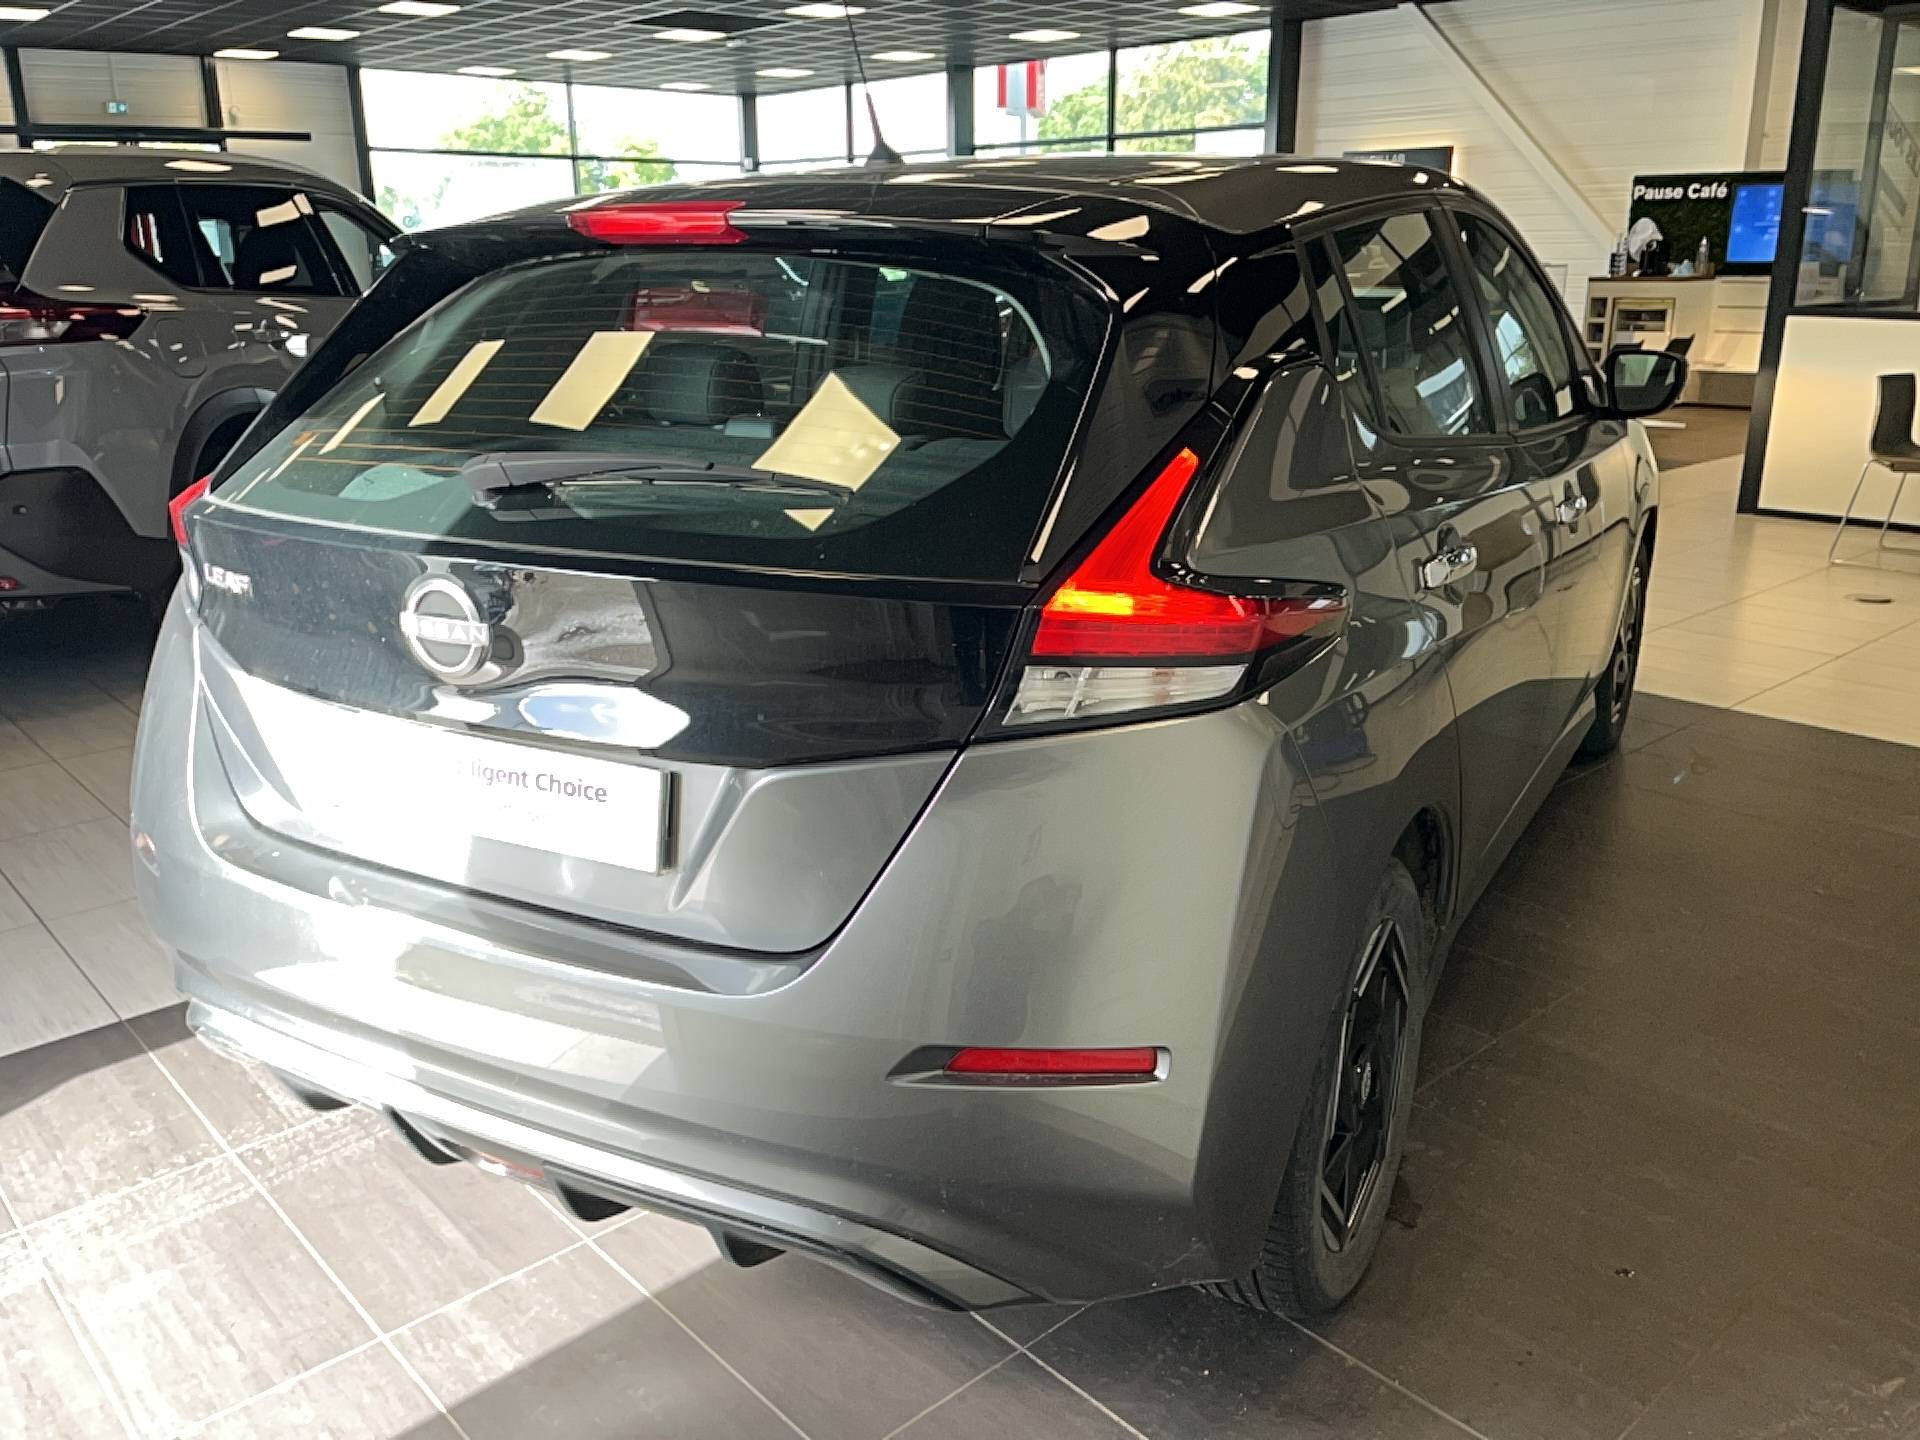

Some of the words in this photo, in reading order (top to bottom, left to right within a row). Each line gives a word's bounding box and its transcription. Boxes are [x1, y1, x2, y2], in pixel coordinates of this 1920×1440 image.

[1633, 185, 1684, 200] Pause
[1687, 182, 1729, 199] Café
[535, 773, 608, 802] Choice
